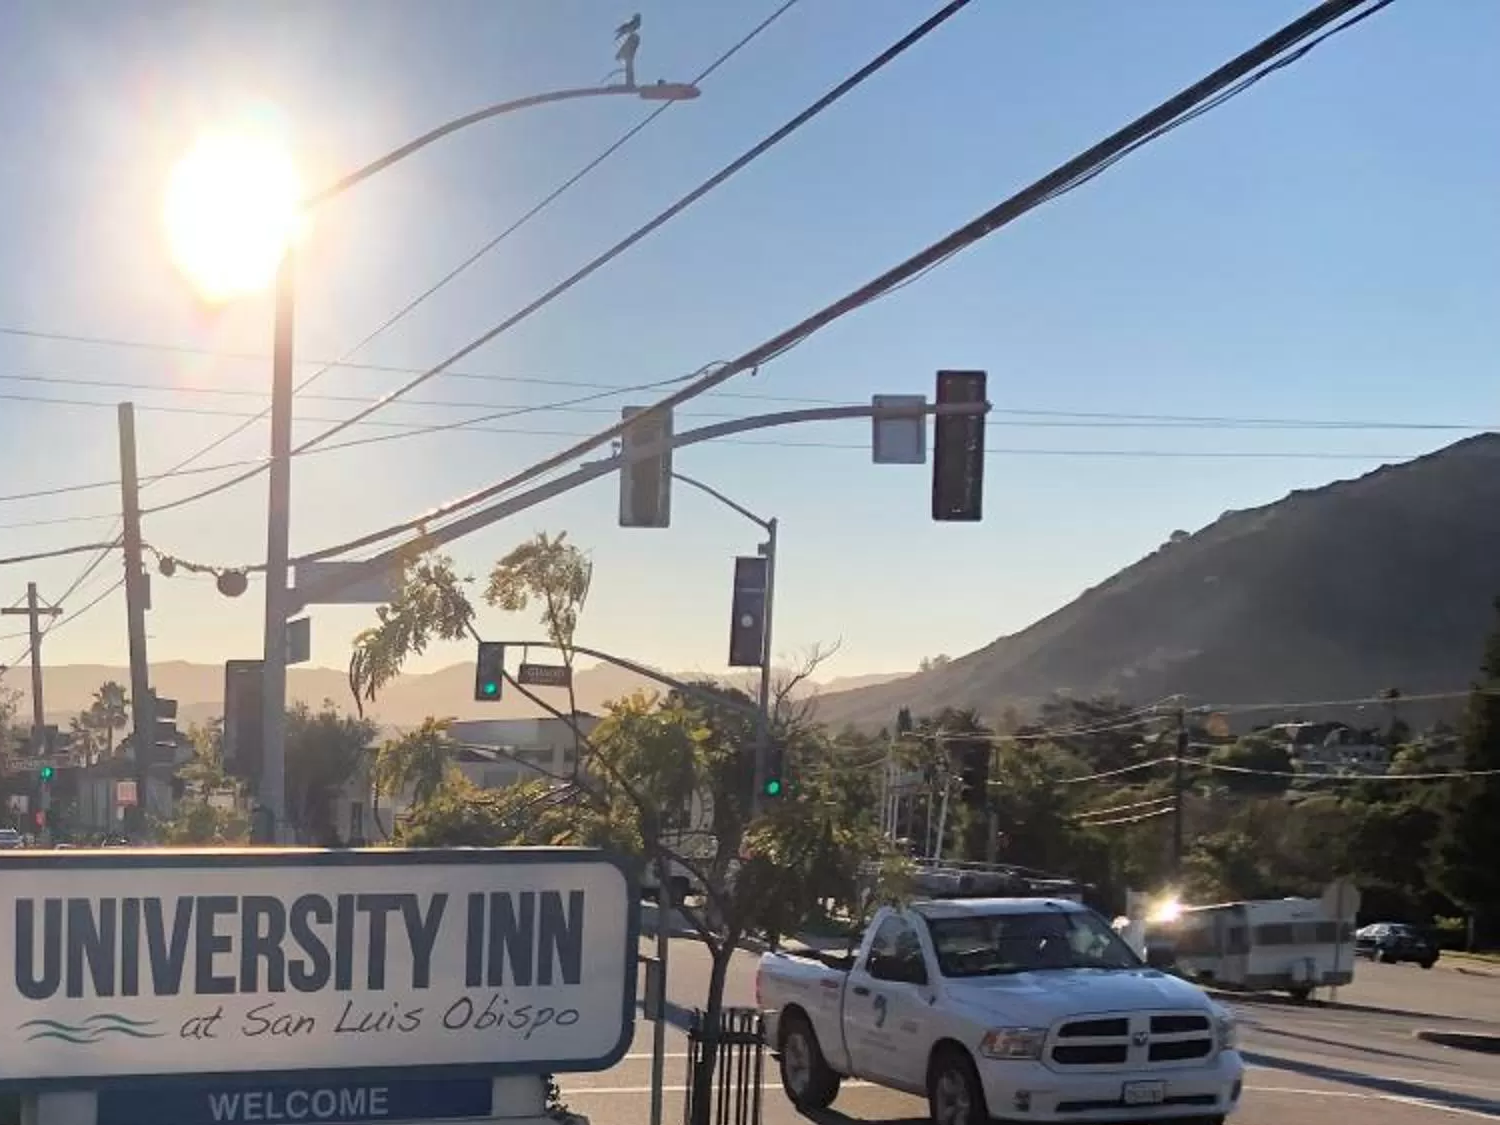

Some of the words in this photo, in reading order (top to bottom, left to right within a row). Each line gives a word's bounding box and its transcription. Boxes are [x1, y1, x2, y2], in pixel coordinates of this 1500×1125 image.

[15, 892, 449, 1000] UNIVERSITY
[464, 889, 585, 989] INN
[180, 1006, 222, 1040] at
[242, 1002, 316, 1037] San
[334, 1000, 425, 1033] Luis
[443, 994, 581, 1041] Obispo
[208, 1087, 389, 1121] WELCOME
